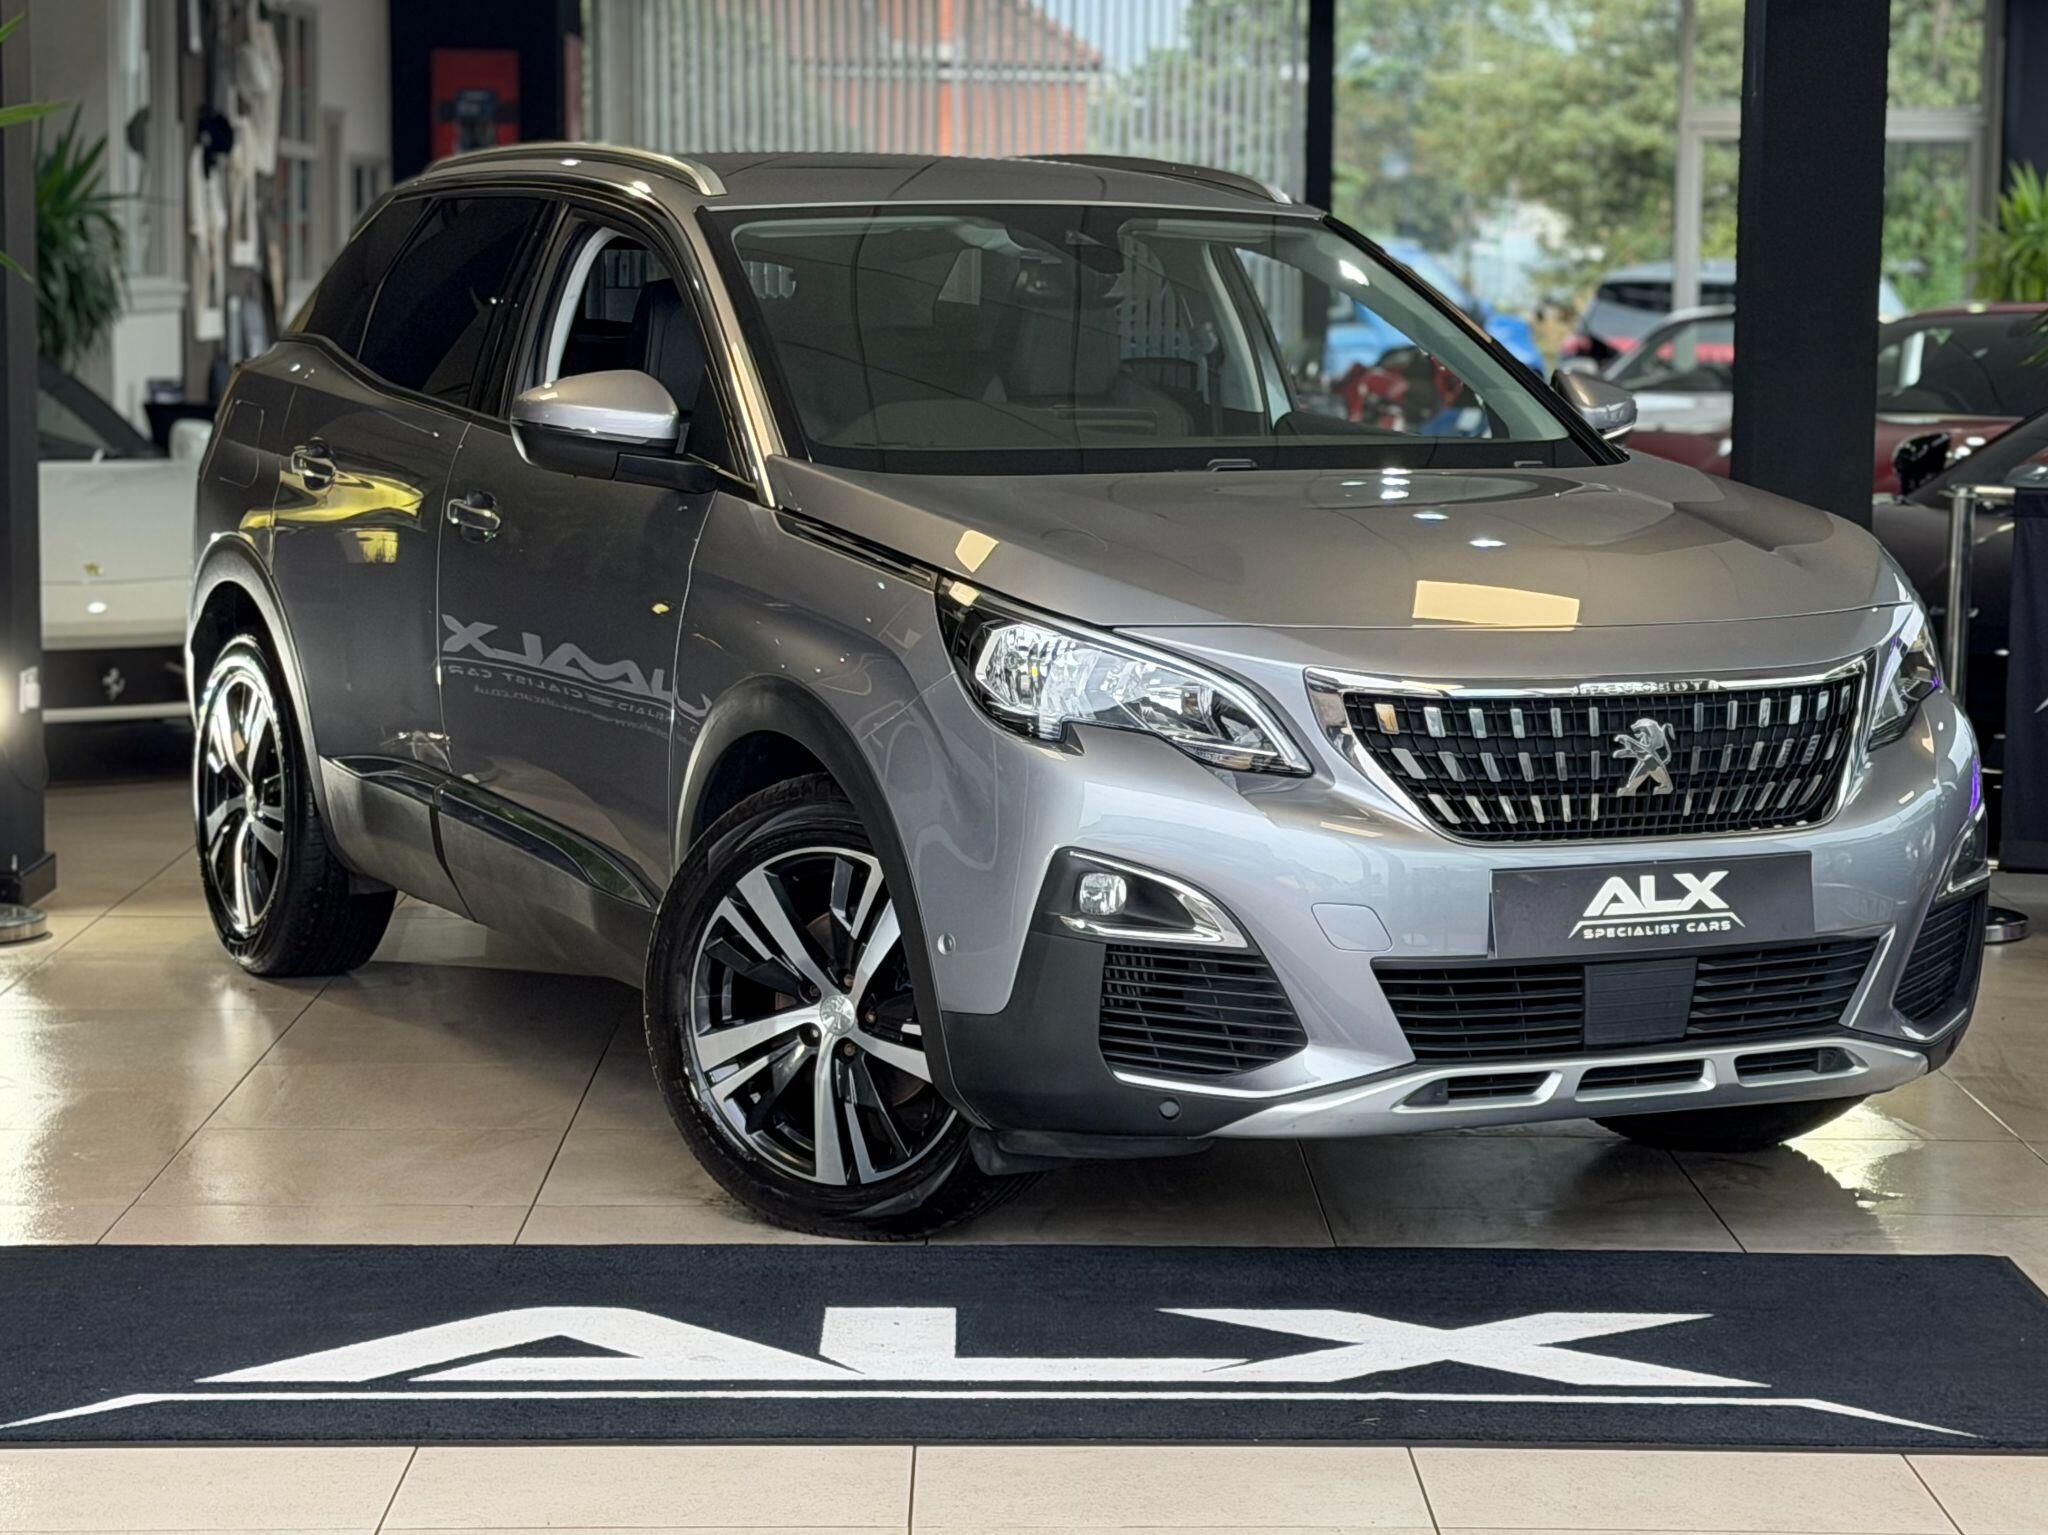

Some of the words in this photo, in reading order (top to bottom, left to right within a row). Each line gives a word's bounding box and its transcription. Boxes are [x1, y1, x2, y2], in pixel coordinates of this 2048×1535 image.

[1582, 870, 1731, 918] ALX
[1582, 923, 1681, 940] SPECIALIST
[1685, 919, 1732, 934] CARS
[193, 1305, 1772, 1388] ALX
